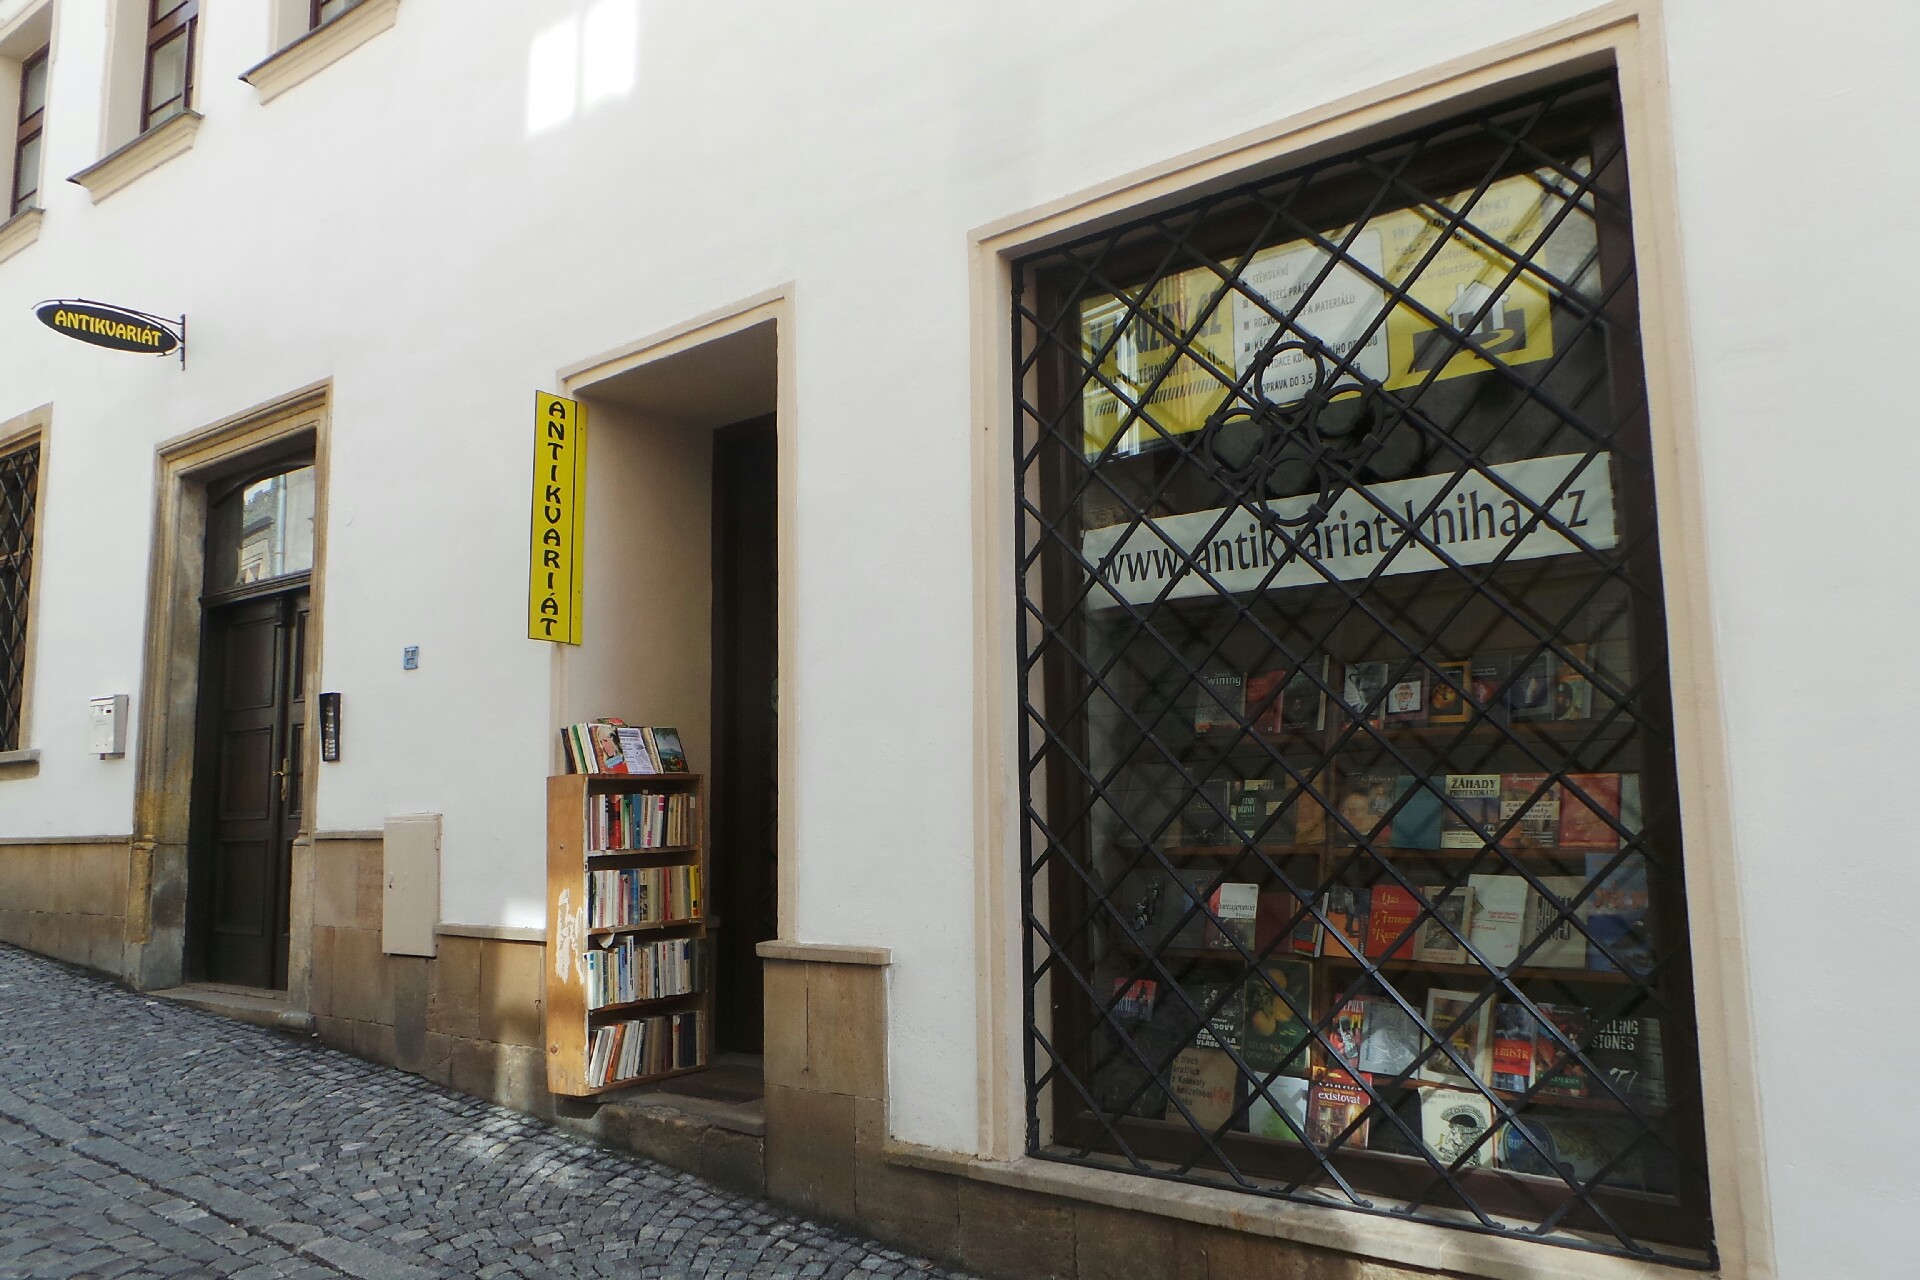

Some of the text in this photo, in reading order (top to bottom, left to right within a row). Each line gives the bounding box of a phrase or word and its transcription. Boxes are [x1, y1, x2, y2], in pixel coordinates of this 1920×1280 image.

[54, 309, 162, 347] ANTIKVARIÁT
[1289, 376, 1299, 388] DO
[1301, 373, 1313, 386] 3,5
[540, 400, 566, 637] ANTIKVARIÁT
[1203, 675, 1242, 688] Twining
[1591, 1034, 1635, 1051] STONES
[1318, 1092, 1361, 1105] existovat
